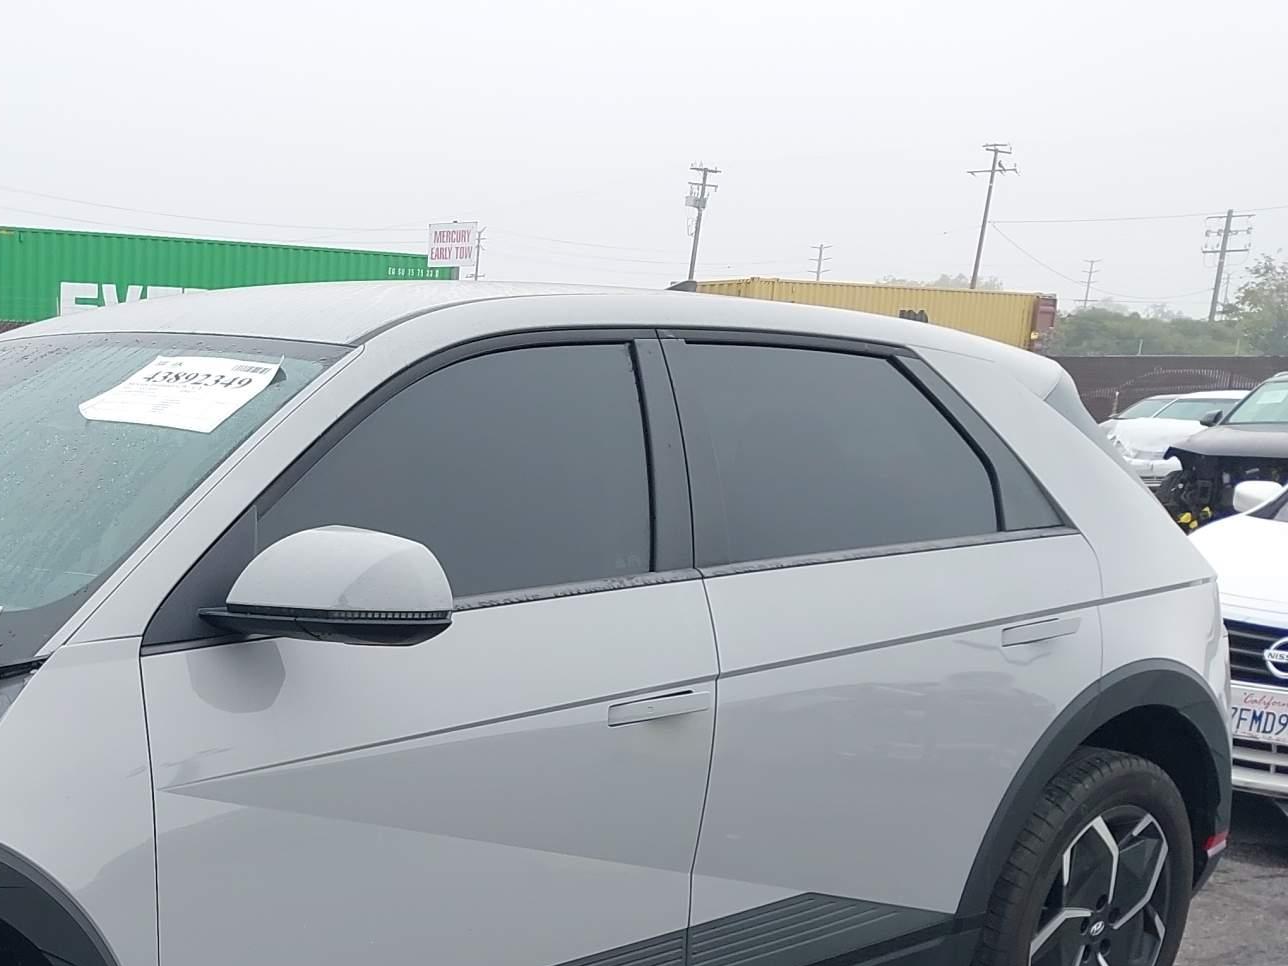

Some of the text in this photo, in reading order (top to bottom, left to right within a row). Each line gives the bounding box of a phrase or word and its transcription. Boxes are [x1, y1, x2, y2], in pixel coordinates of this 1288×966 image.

[434, 229, 471, 243] MERCURY
[431, 246, 473, 260] EARLY TOW
[143, 370, 253, 389] 43892349
